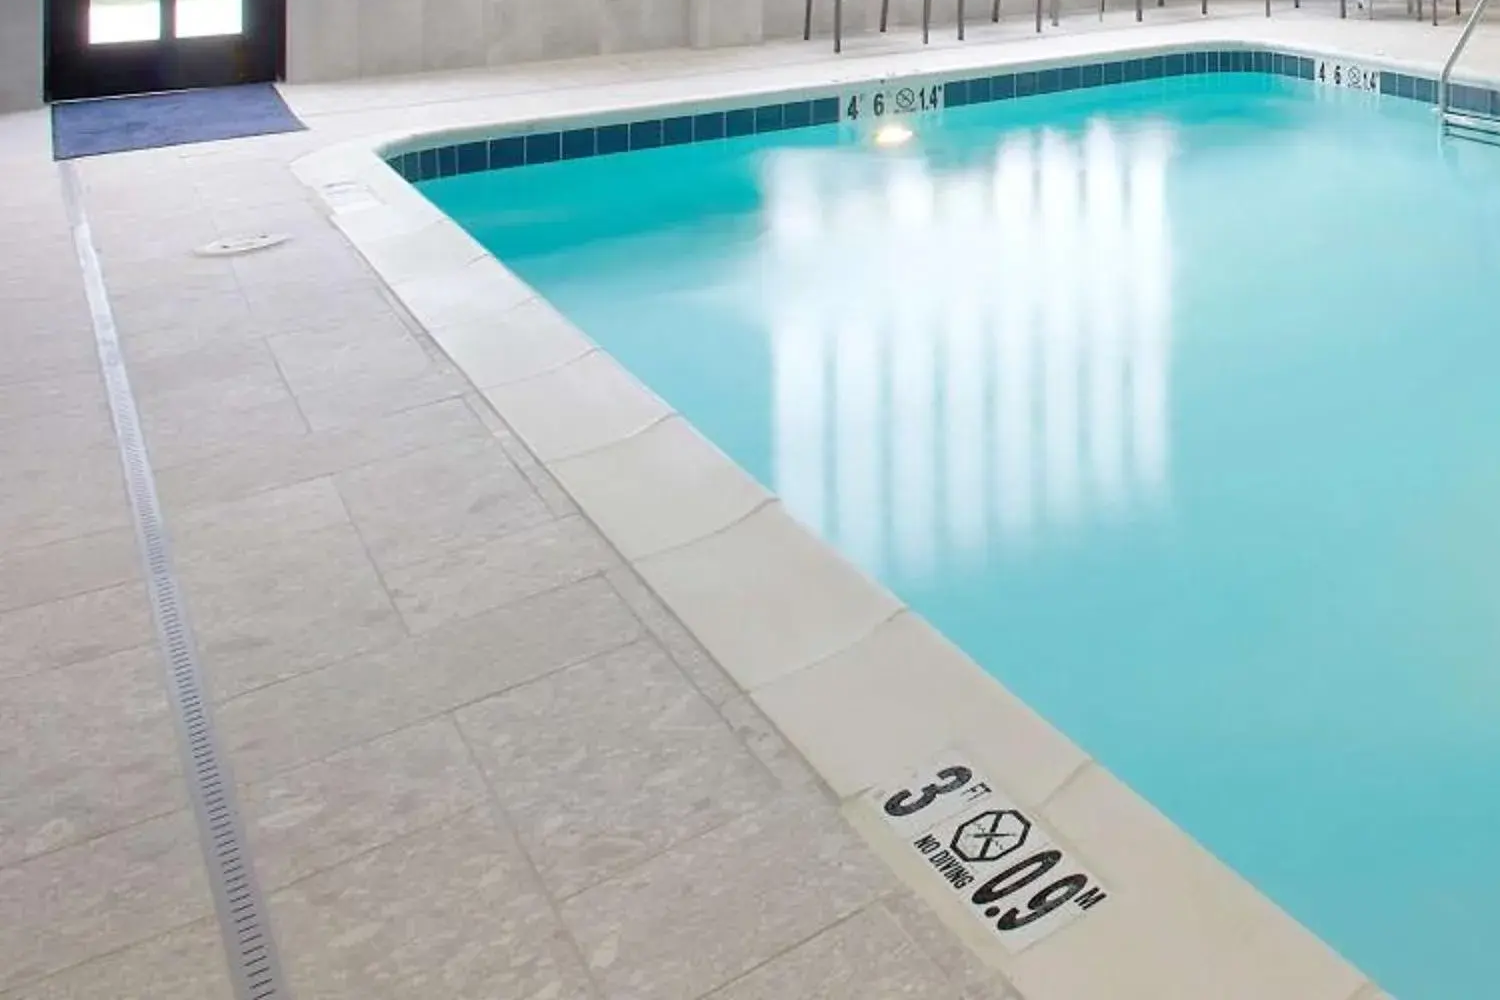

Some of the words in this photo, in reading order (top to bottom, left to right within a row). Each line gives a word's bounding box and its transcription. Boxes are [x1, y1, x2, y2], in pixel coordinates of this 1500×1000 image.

[1319, 61, 1326, 82] 4
[847, 95, 858, 120] 4
[873, 93, 884, 116] 6
[884, 766, 973, 817] 3
[914, 834, 941, 855] NO
[929, 850, 975, 889] DIVING
